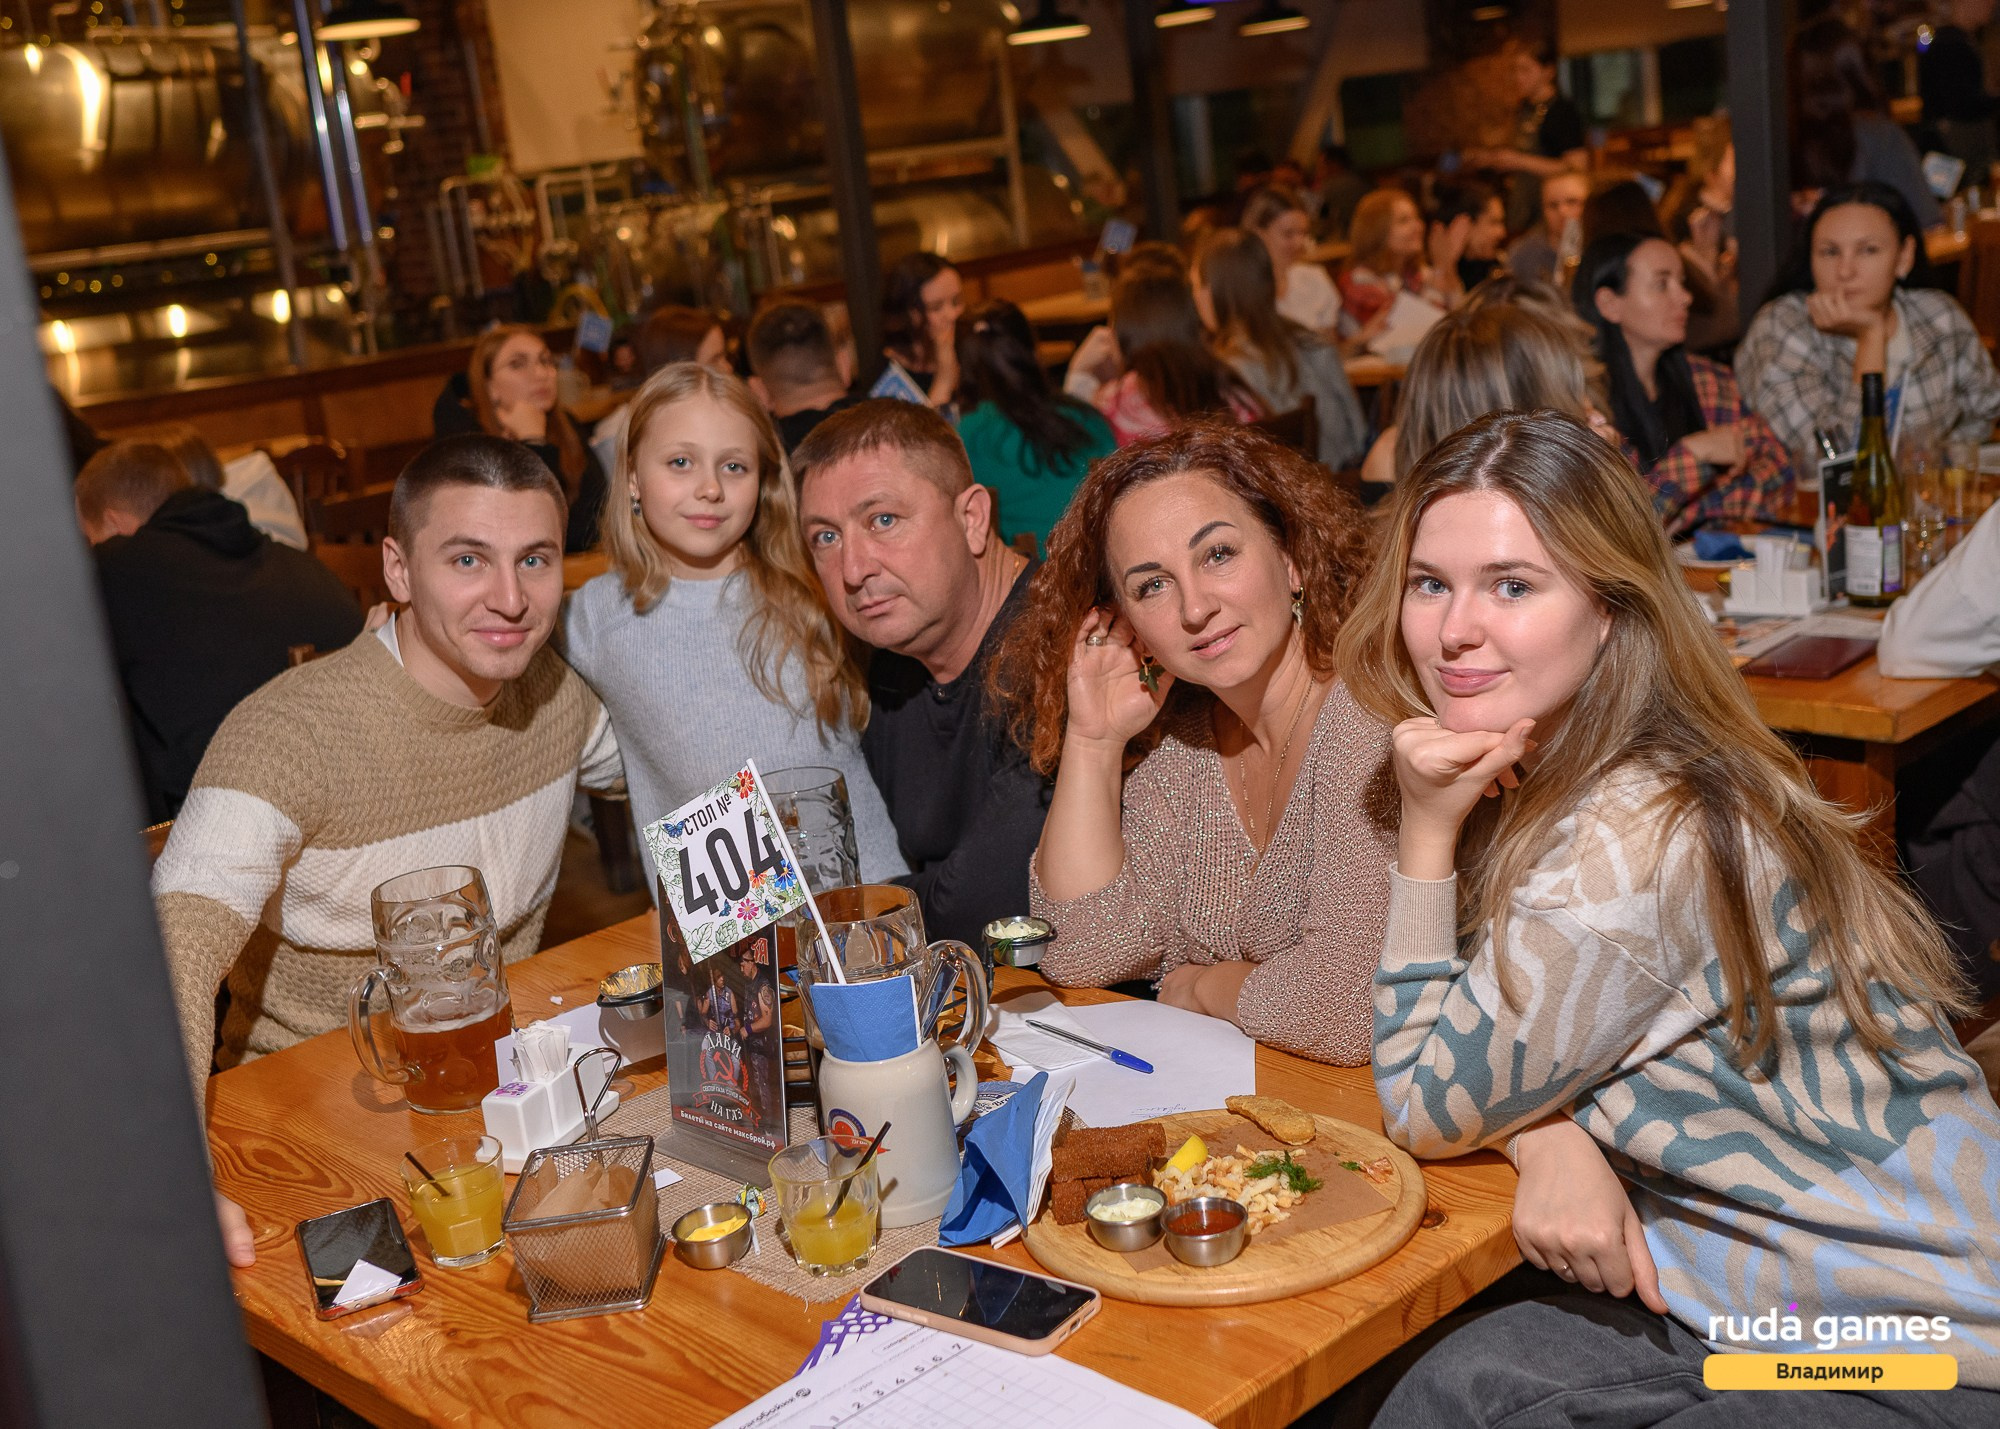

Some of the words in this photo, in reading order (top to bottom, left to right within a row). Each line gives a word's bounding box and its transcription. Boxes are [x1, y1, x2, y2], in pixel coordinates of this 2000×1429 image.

[683, 807, 718, 836] СТОЛ
[717, 793, 732, 814] №
[678, 808, 784, 916] 404
[705, 1032, 742, 1059] ДАВИ
[680, 1110, 704, 1123] Билеты
[704, 1118, 714, 1127] на
[714, 1121, 733, 1134] сайте
[711, 1100, 723, 1117] НА
[726, 1107, 743, 1121] ГАЗ
[852, 1401, 864, 1410] 2
[914, 1365, 925, 1373] 5
